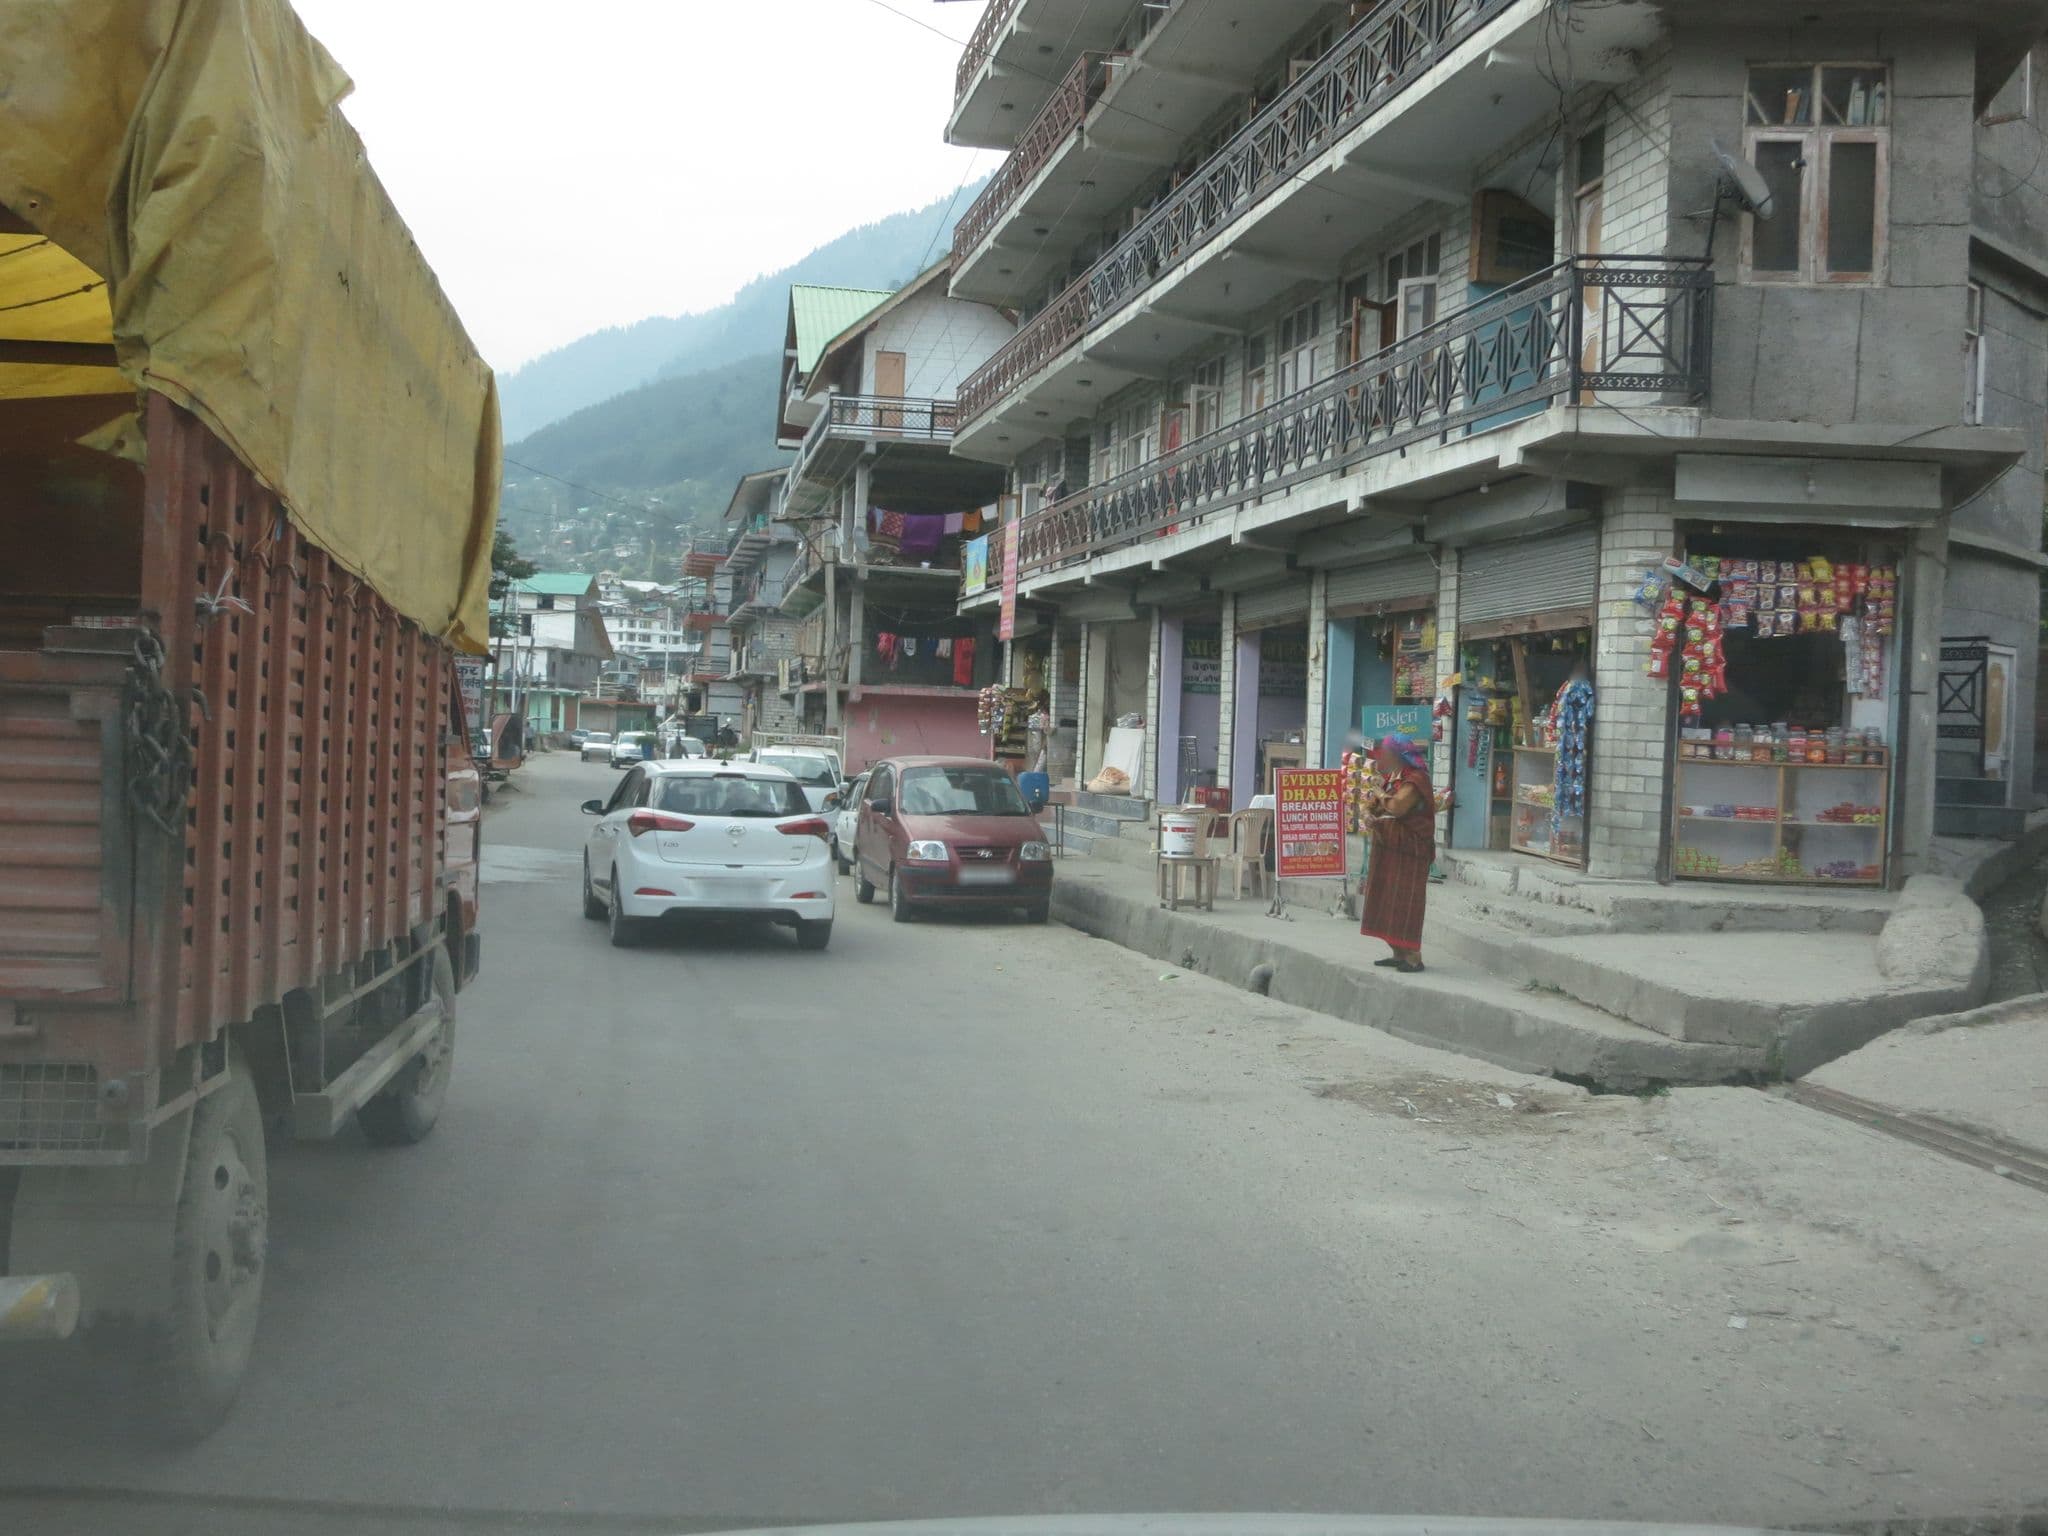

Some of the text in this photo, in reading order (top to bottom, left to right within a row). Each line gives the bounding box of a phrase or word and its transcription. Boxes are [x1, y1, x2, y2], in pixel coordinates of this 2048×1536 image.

[1376, 707, 1418, 729] Bisleri
[1282, 773, 1338, 787] EVEREST
[1283, 788, 1338, 801] DHABA
[1281, 801, 1338, 812] BREAKFAST
[1281, 812, 1338, 823] LUNCH DINNER
